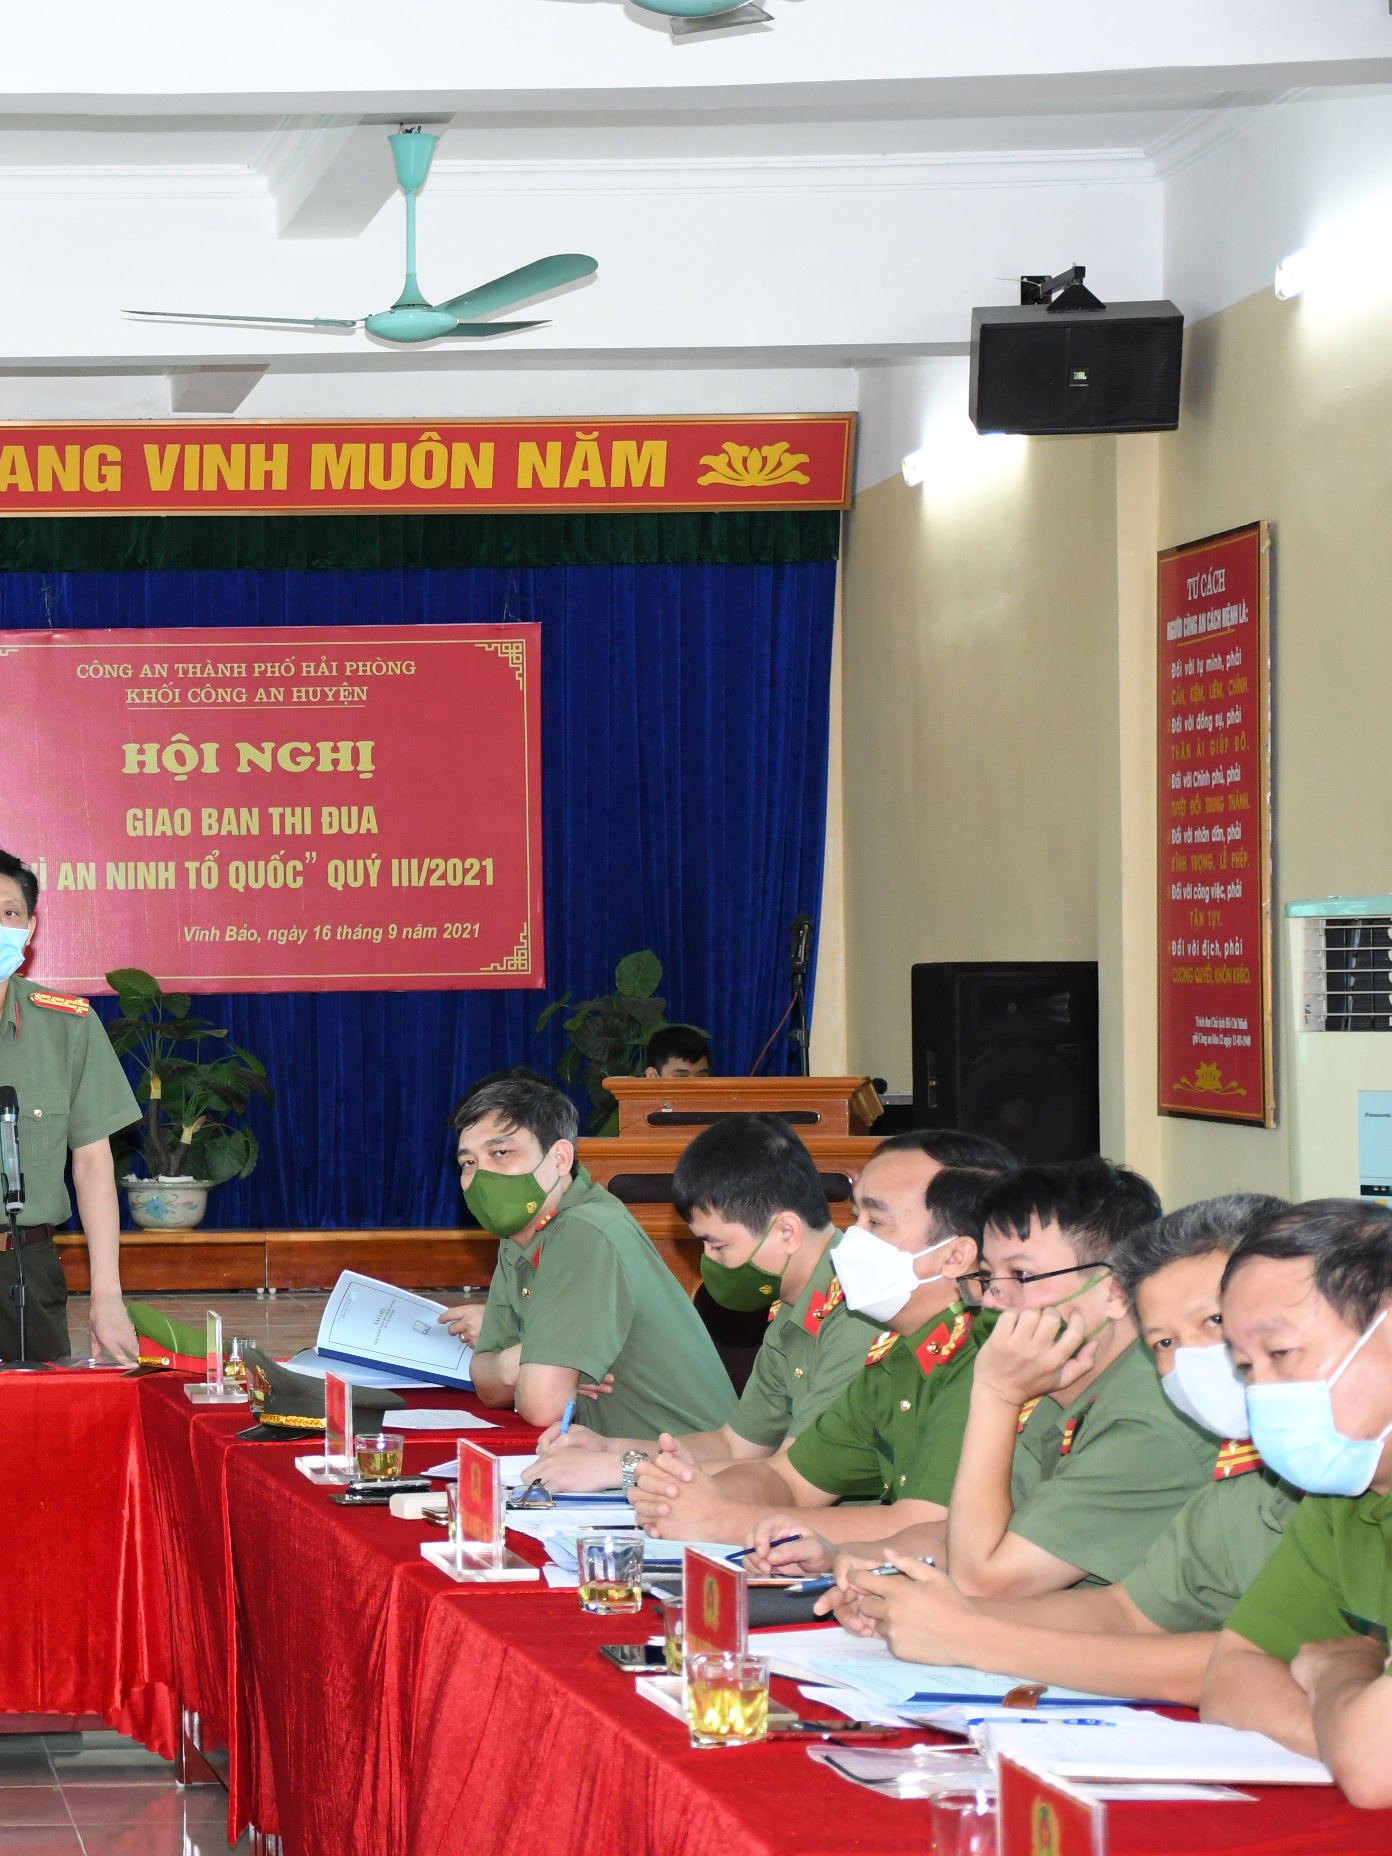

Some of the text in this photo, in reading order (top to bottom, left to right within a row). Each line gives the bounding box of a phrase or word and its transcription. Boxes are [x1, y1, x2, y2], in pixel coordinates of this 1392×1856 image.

[144, 443, 289, 491] VINH
[310, 431, 495, 490] MUÔN
[517, 431, 668, 488] NĂM
[1187, 566, 1226, 600] TƯ CÁCH
[76, 656, 417, 679] CÔNG AN THÀNH PHỐ HẢI PHÒNG
[1172, 659, 1182, 678] Đối
[1185, 658, 1194, 675] với
[1226, 646, 1242, 671] phải
[126, 682, 369, 705] KHỐI CÔNG AN HUYỆN
[1172, 714, 1182, 733] Đối
[1185, 714, 1194, 731] với
[1196, 710, 1212, 732] đồng
[1227, 704, 1242, 728] phải
[121, 733, 376, 782] HỘI NGHỊ
[1210, 733, 1229, 756] GIÚP
[1172, 770, 1181, 789] Đối
[1183, 771, 1192, 787] với
[1193, 769, 1210, 787] Chính
[1227, 762, 1241, 786] phải
[126, 805, 379, 837] GIAO BAN THI ĐUA
[1172, 825, 1181, 844] Đối
[1184, 826, 1192, 843] với
[1227, 820, 1242, 844] phải
[57, 862, 97, 891] AN
[107, 861, 176, 890] NINH
[184, 849, 220, 890] TỔ
[327, 852, 382, 891] QUÝ
[391, 857, 495, 888] III/2021
[1172, 881, 1182, 900] Đối
[1183, 883, 1192, 899] với
[1193, 883, 1209, 903] công
[1227, 878, 1242, 902] phải
[184, 922, 481, 945] Vĩnh Bảo, ngày 16 tháng 9 năm 2021
[1172, 936, 1243, 959] Đối với địch, phải
